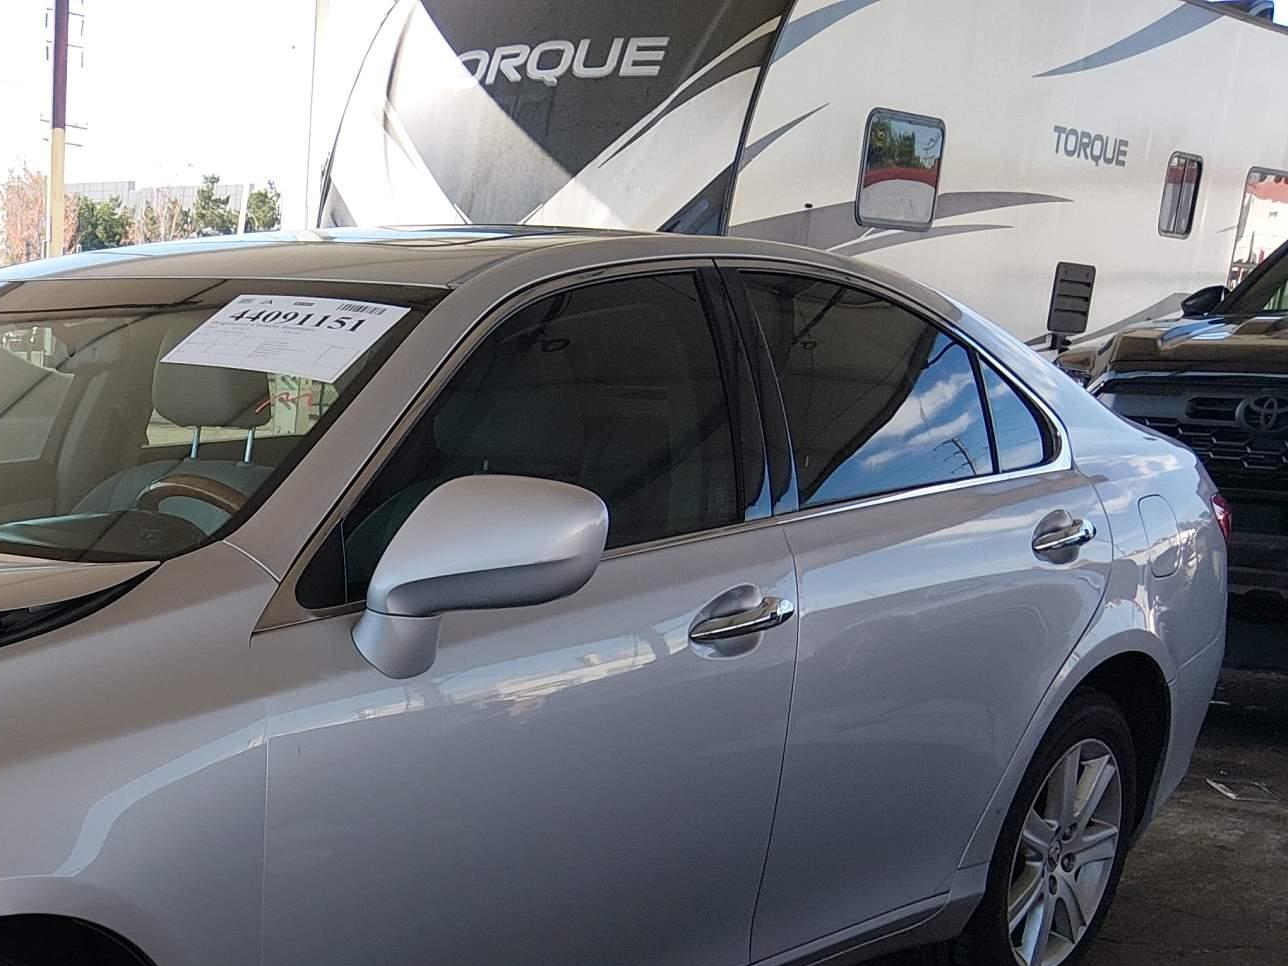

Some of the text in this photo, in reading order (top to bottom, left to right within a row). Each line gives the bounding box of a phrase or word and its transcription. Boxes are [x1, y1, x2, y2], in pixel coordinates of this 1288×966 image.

[455, 37, 670, 87] ORQUE
[1053, 125, 1129, 167] TORQUE
[230, 308, 367, 332] 44091151
